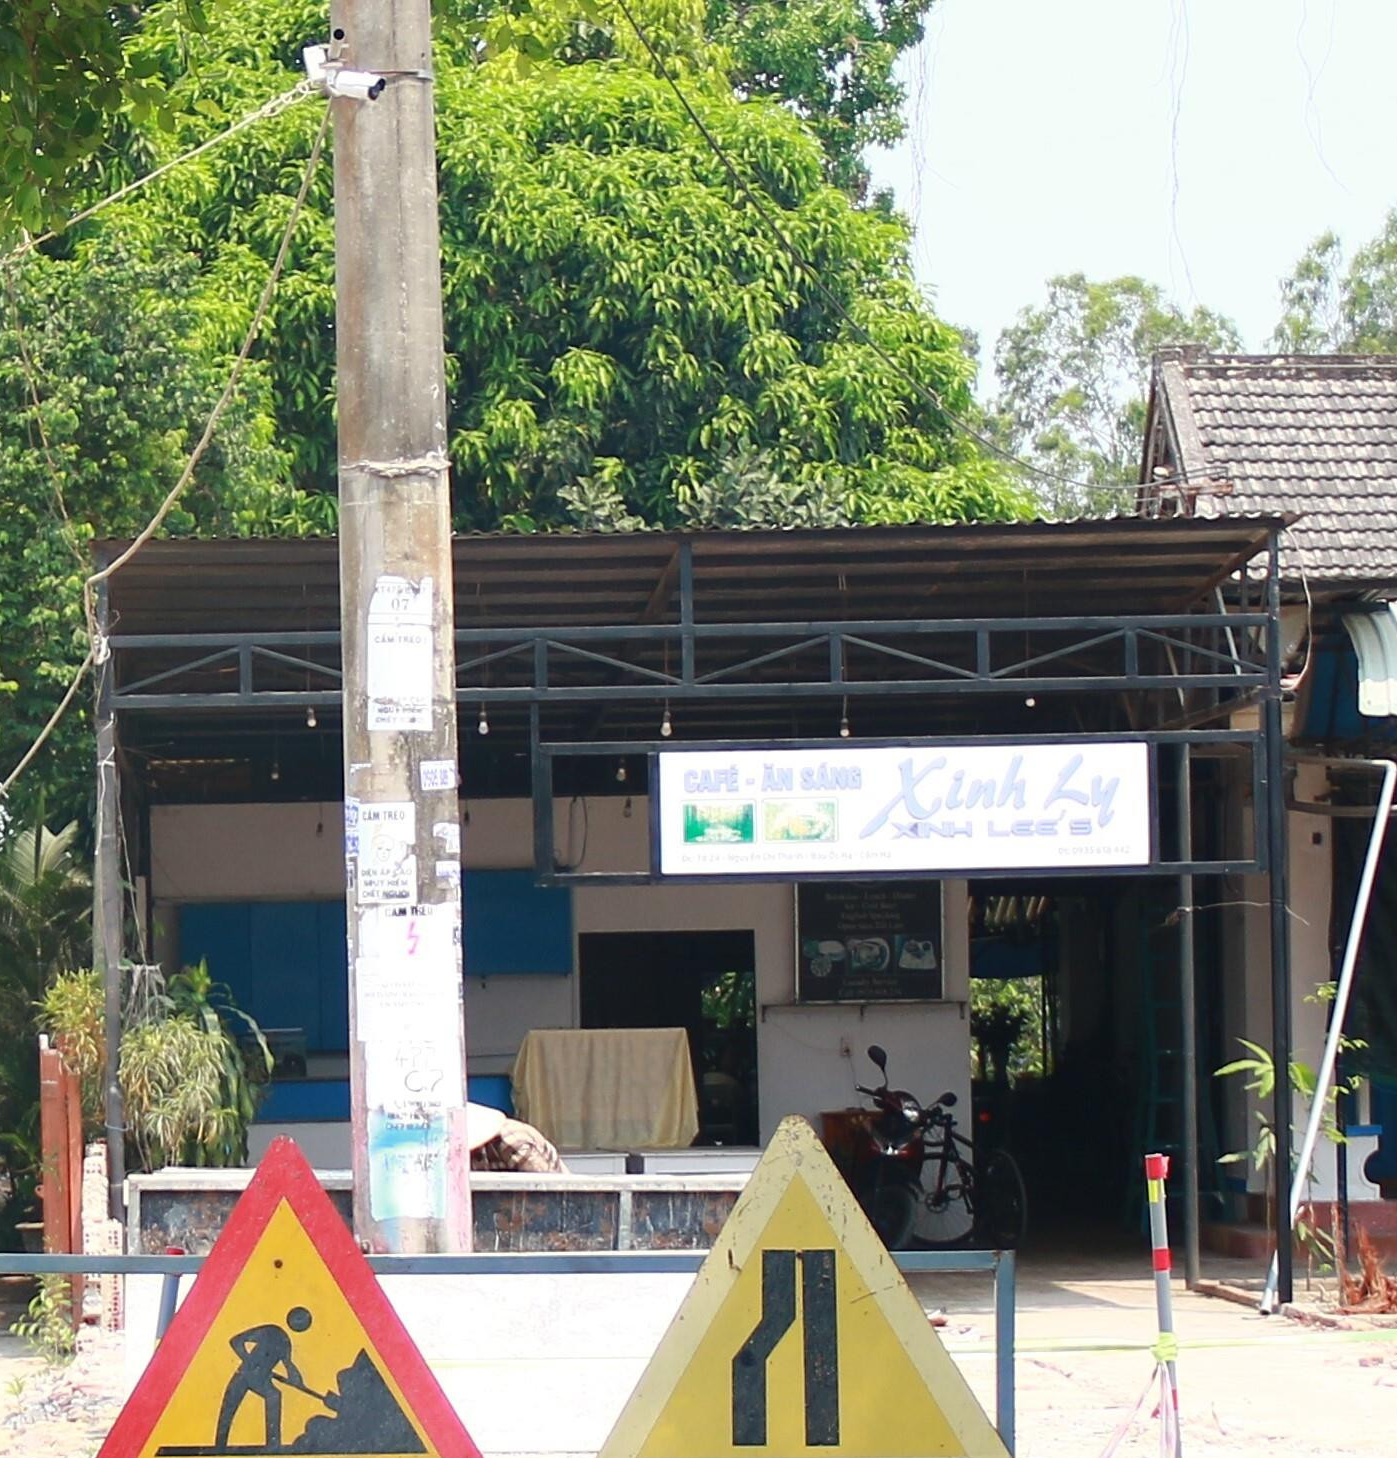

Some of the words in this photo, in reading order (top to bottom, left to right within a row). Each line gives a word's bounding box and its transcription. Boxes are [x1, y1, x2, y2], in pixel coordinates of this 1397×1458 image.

[683, 763, 740, 793] CAFÉ
[760, 762, 794, 792] ĂN
[799, 761, 863, 791] SÁNG
[859, 754, 1026, 840] Xinh
[1042, 754, 1121, 828] Ly
[891, 820, 973, 840] XINH
